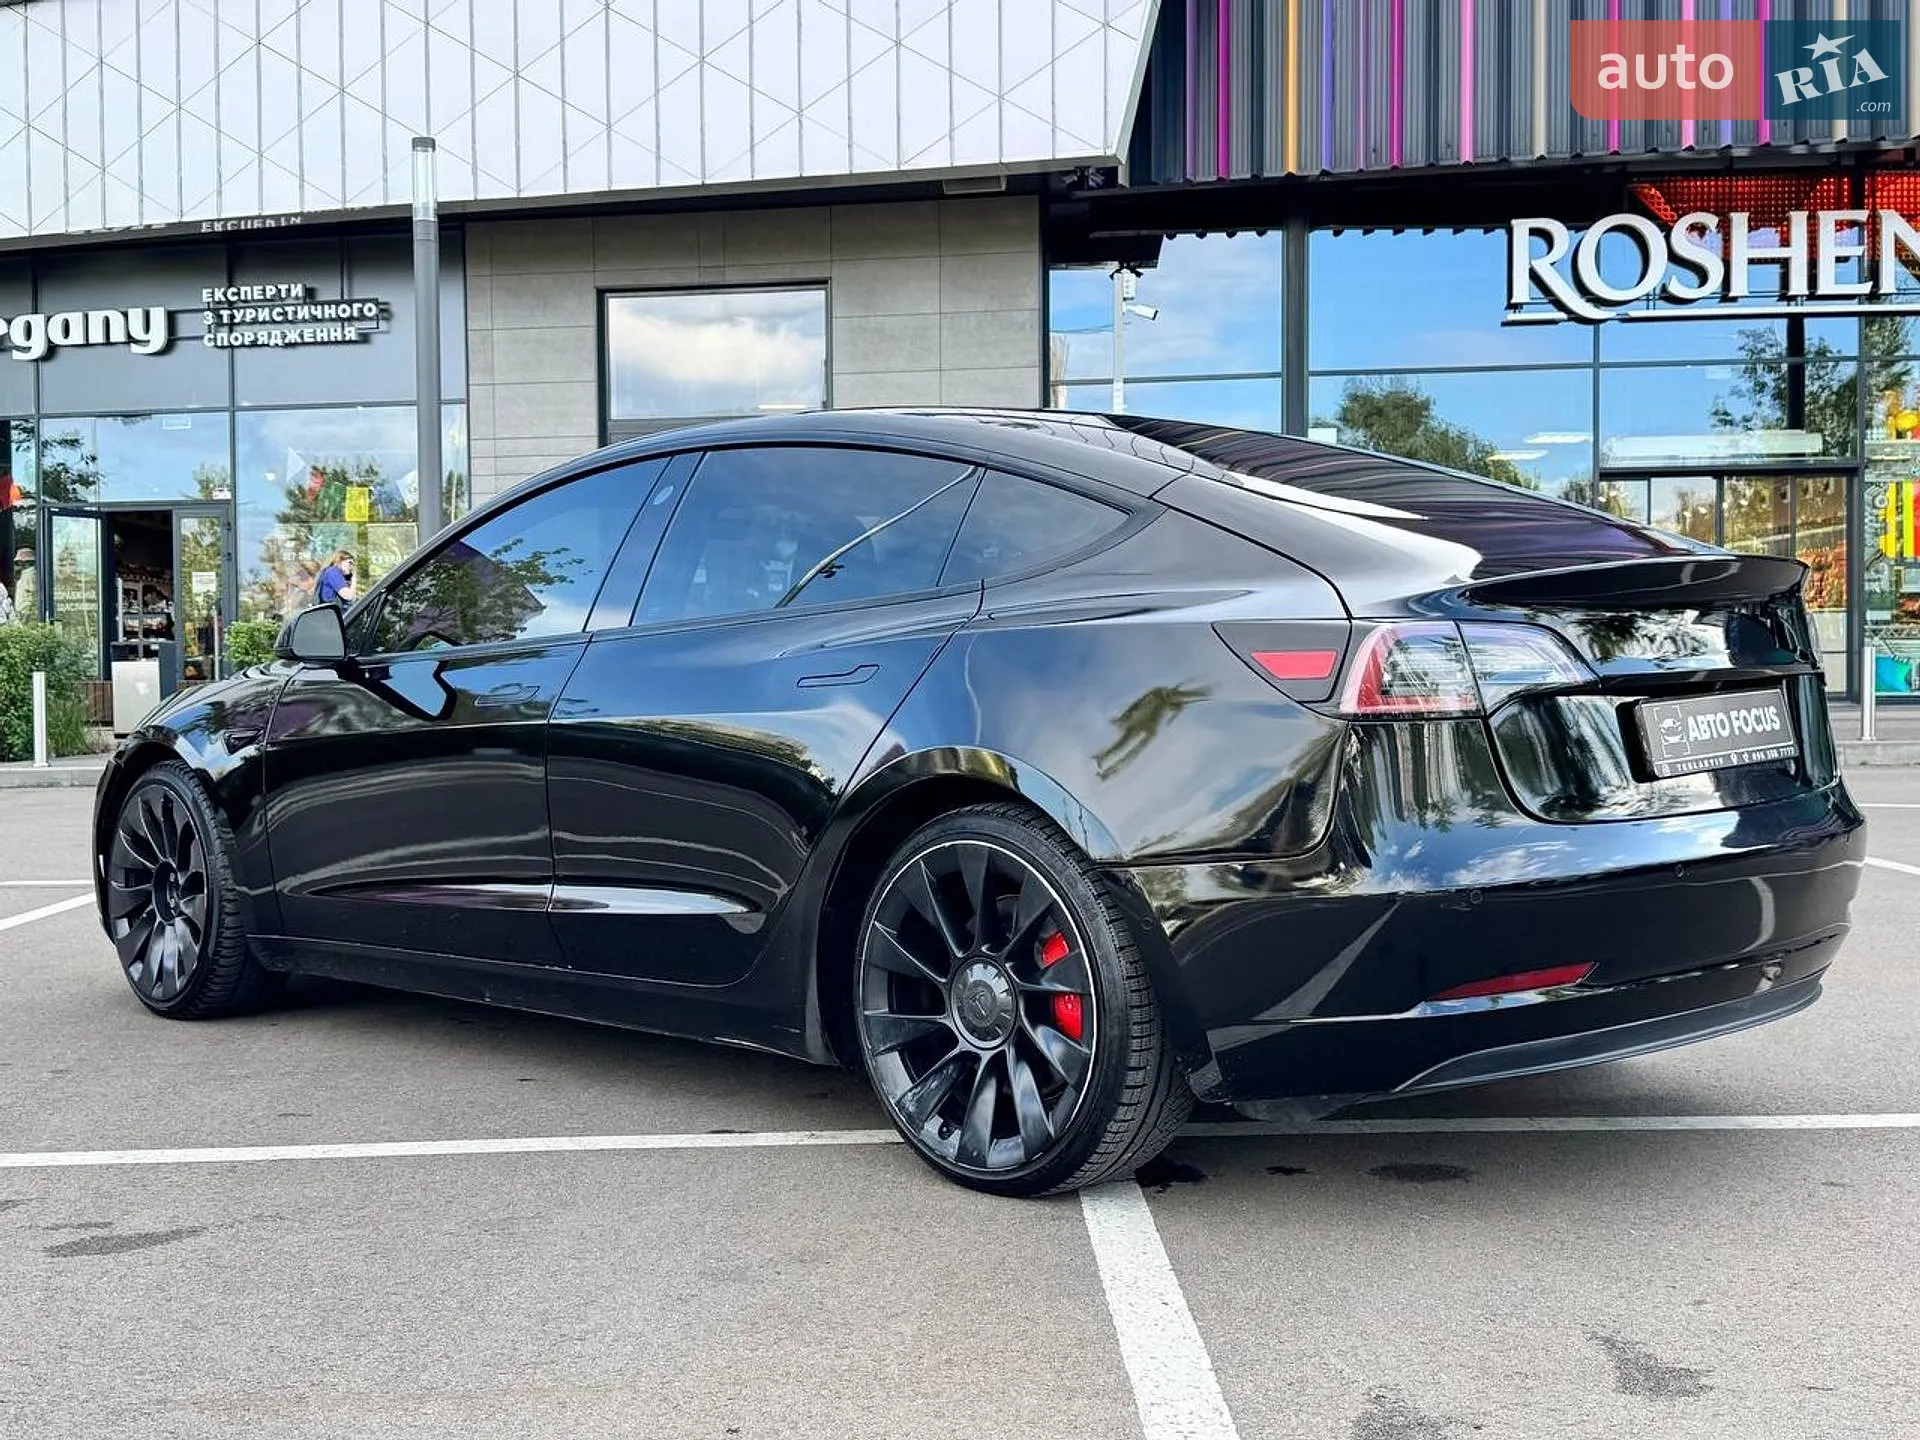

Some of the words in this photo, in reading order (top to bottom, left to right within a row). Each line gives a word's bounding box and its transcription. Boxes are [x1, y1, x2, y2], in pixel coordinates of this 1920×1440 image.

[202, 284, 303, 303] ЕКСПЕРТИ
[219, 302, 378, 325] ТУРИСТИЧНОГО
[202, 326, 357, 348] СПОРЯДЖЕННЯ
[1729, 705, 1781, 736] FOCUS
